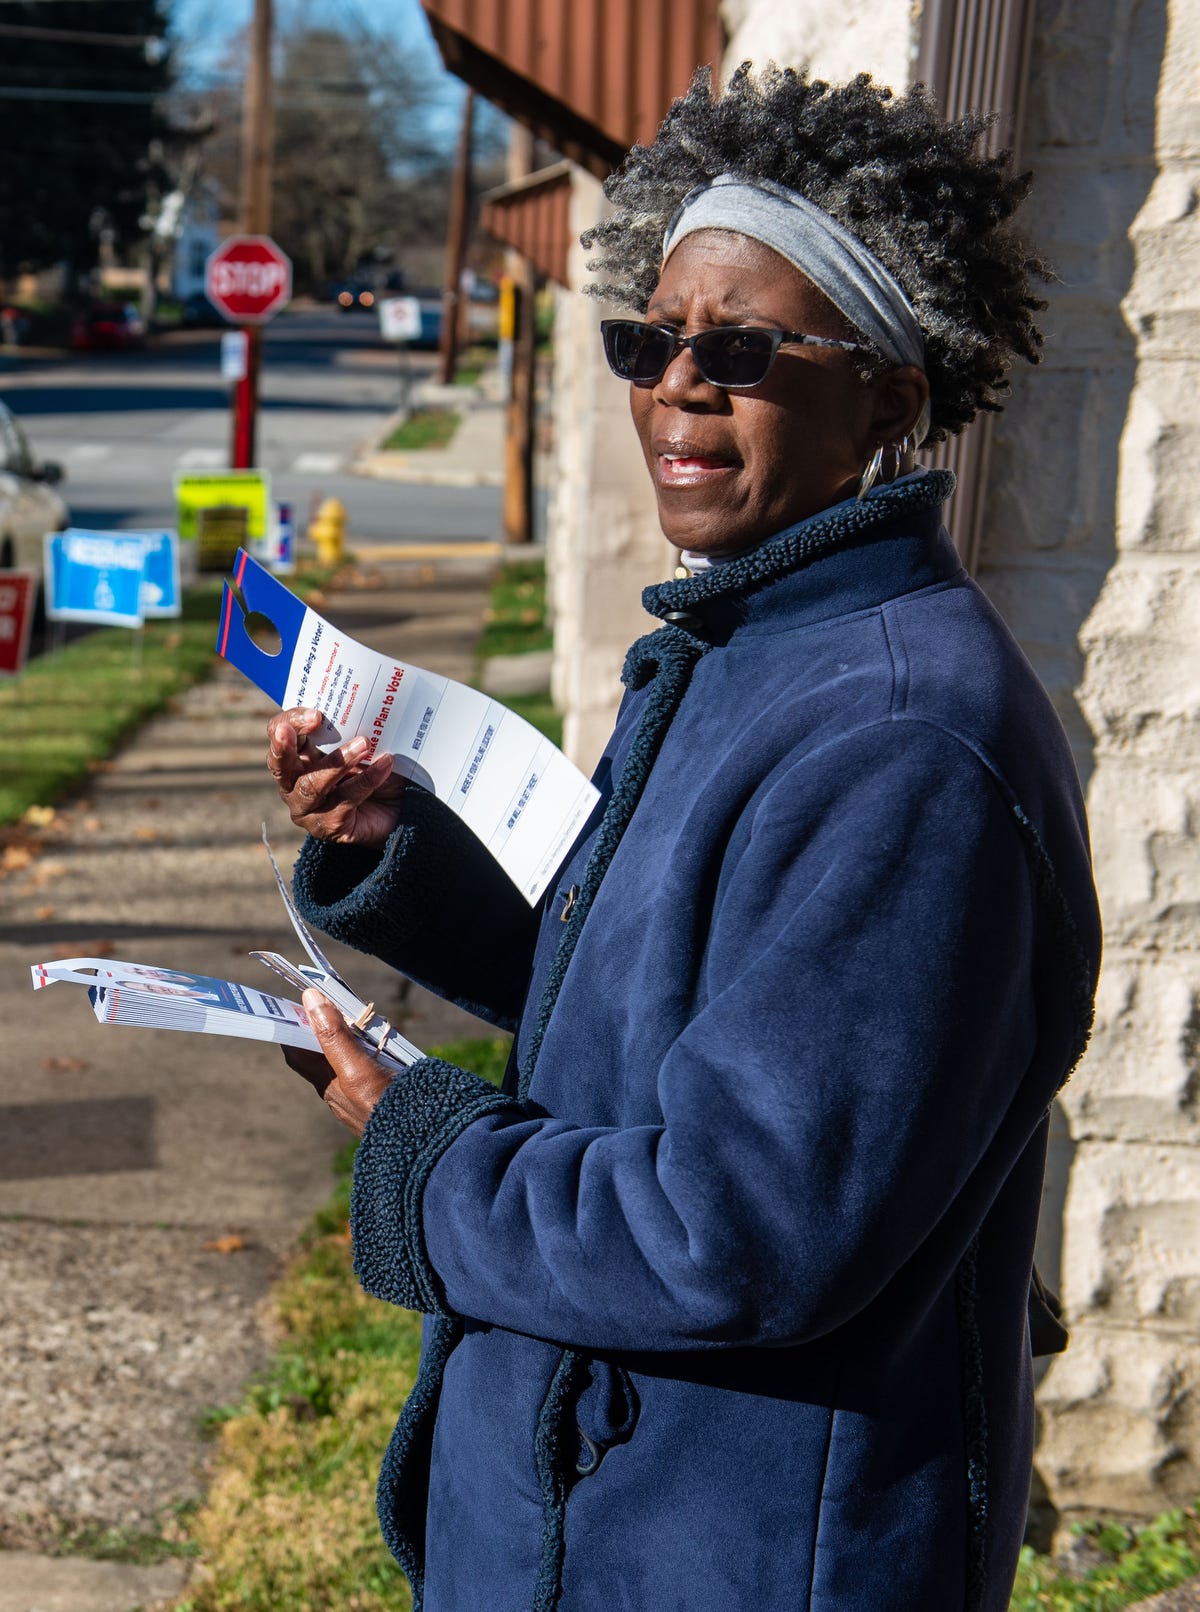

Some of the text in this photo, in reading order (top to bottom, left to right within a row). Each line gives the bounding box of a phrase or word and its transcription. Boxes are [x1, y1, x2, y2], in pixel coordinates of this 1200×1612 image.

[215, 261, 286, 297] STOP
[297, 685, 306, 698] You
[303, 652, 316, 674] Being
[311, 621, 324, 646] Voter!
[325, 647, 337, 673] November
[336, 689, 347, 708] polling
[343, 674, 351, 690] place
[386, 666, 405, 693] Vote!
[383, 695, 394, 706] to
[373, 707, 391, 728] Plan
[373, 729, 382, 737] a
